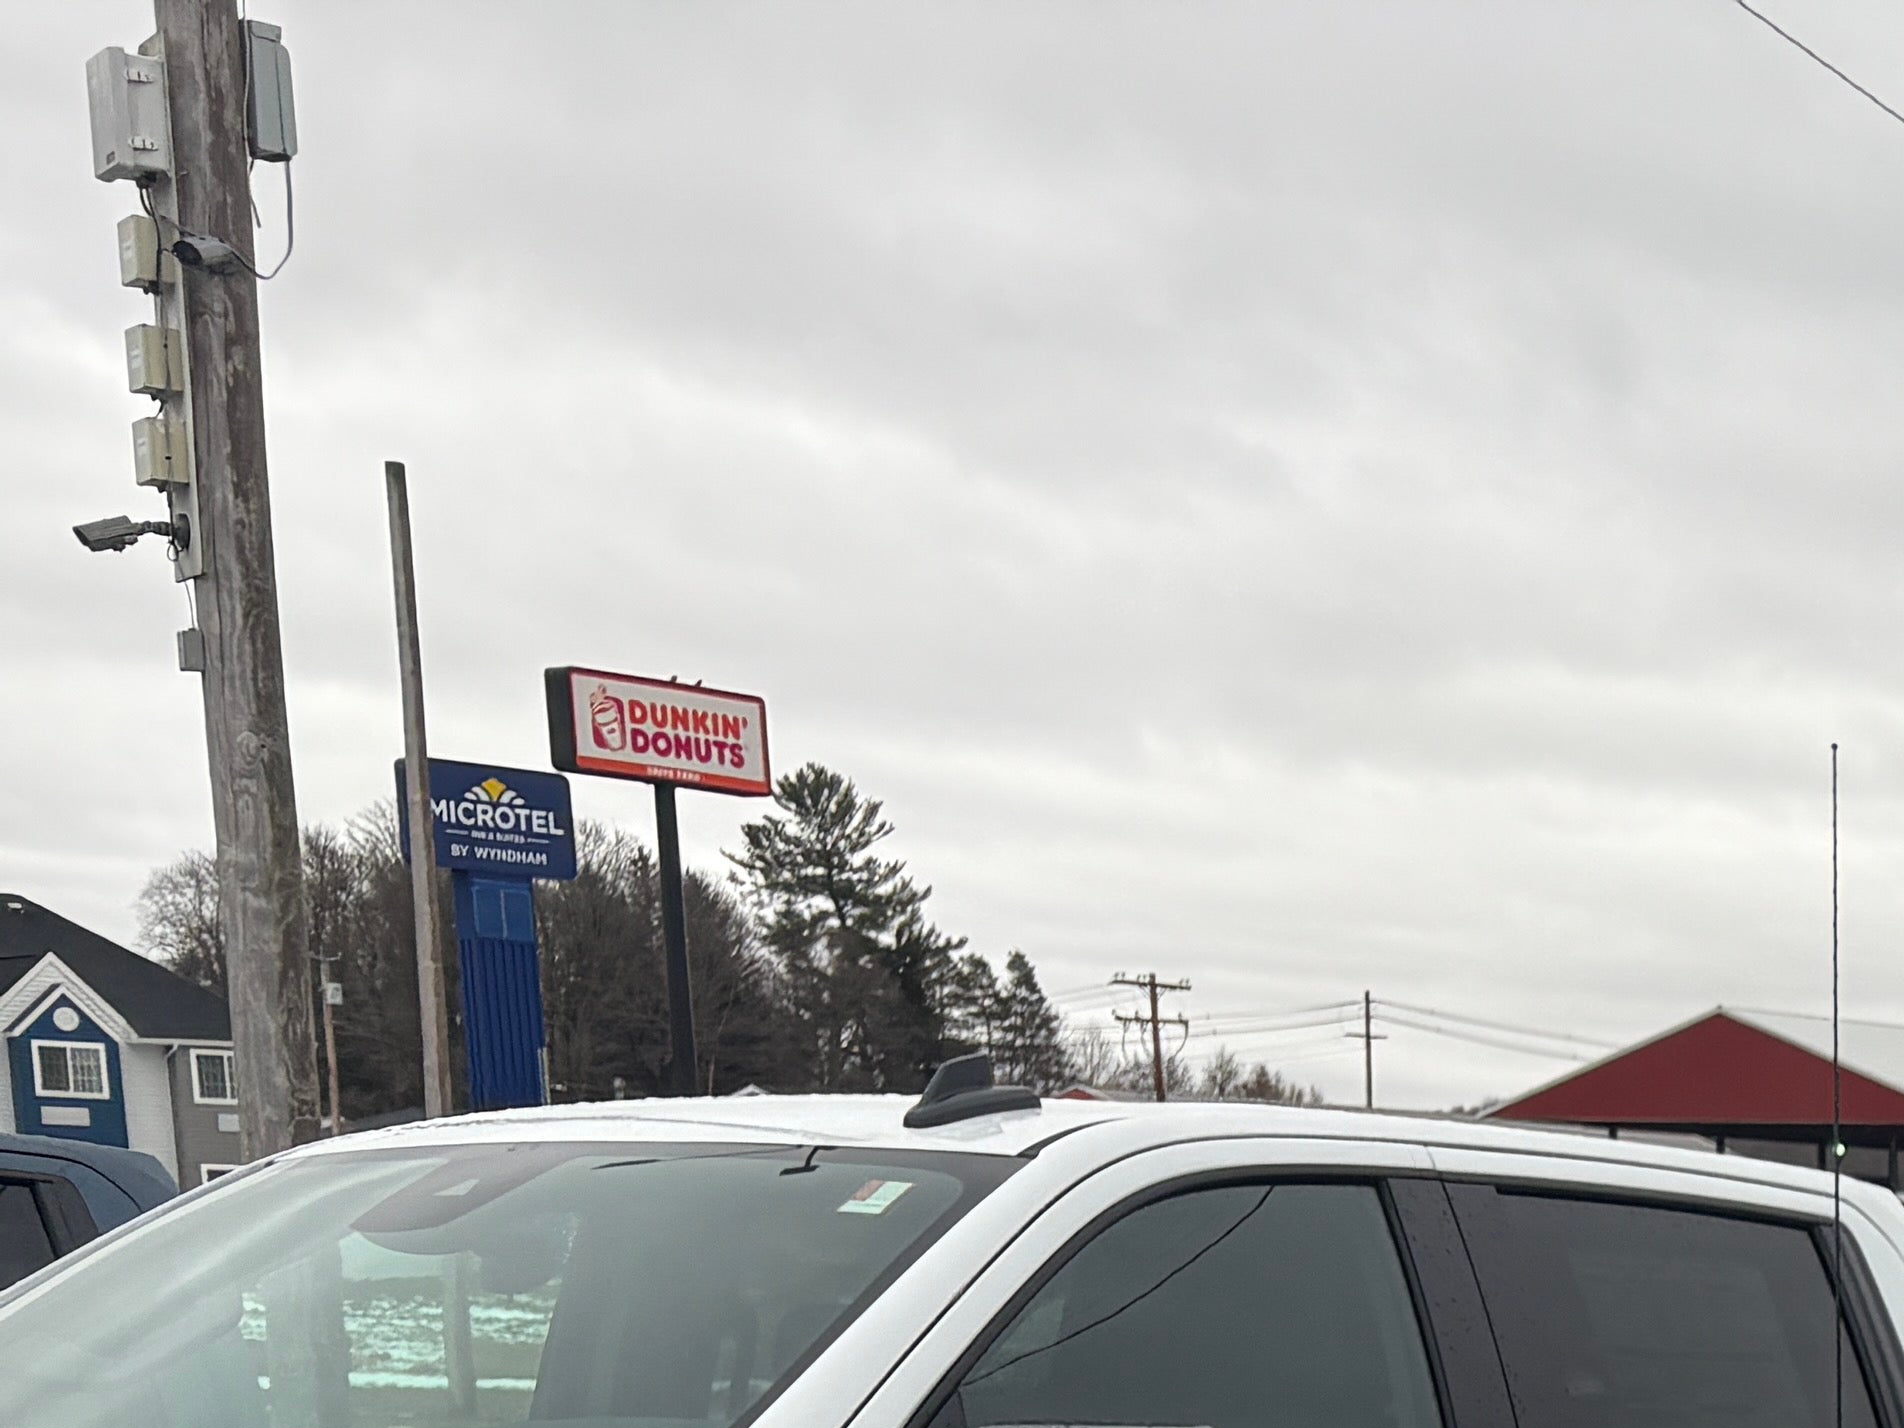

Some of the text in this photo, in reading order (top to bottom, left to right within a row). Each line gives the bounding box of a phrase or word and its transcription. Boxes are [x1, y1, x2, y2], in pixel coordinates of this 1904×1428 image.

[628, 699, 748, 740] DUNKIN'
[630, 728, 745, 769] DONUTS
[430, 797, 565, 836] MICROTEL
[450, 843, 548, 865] BY WYNDHAM
